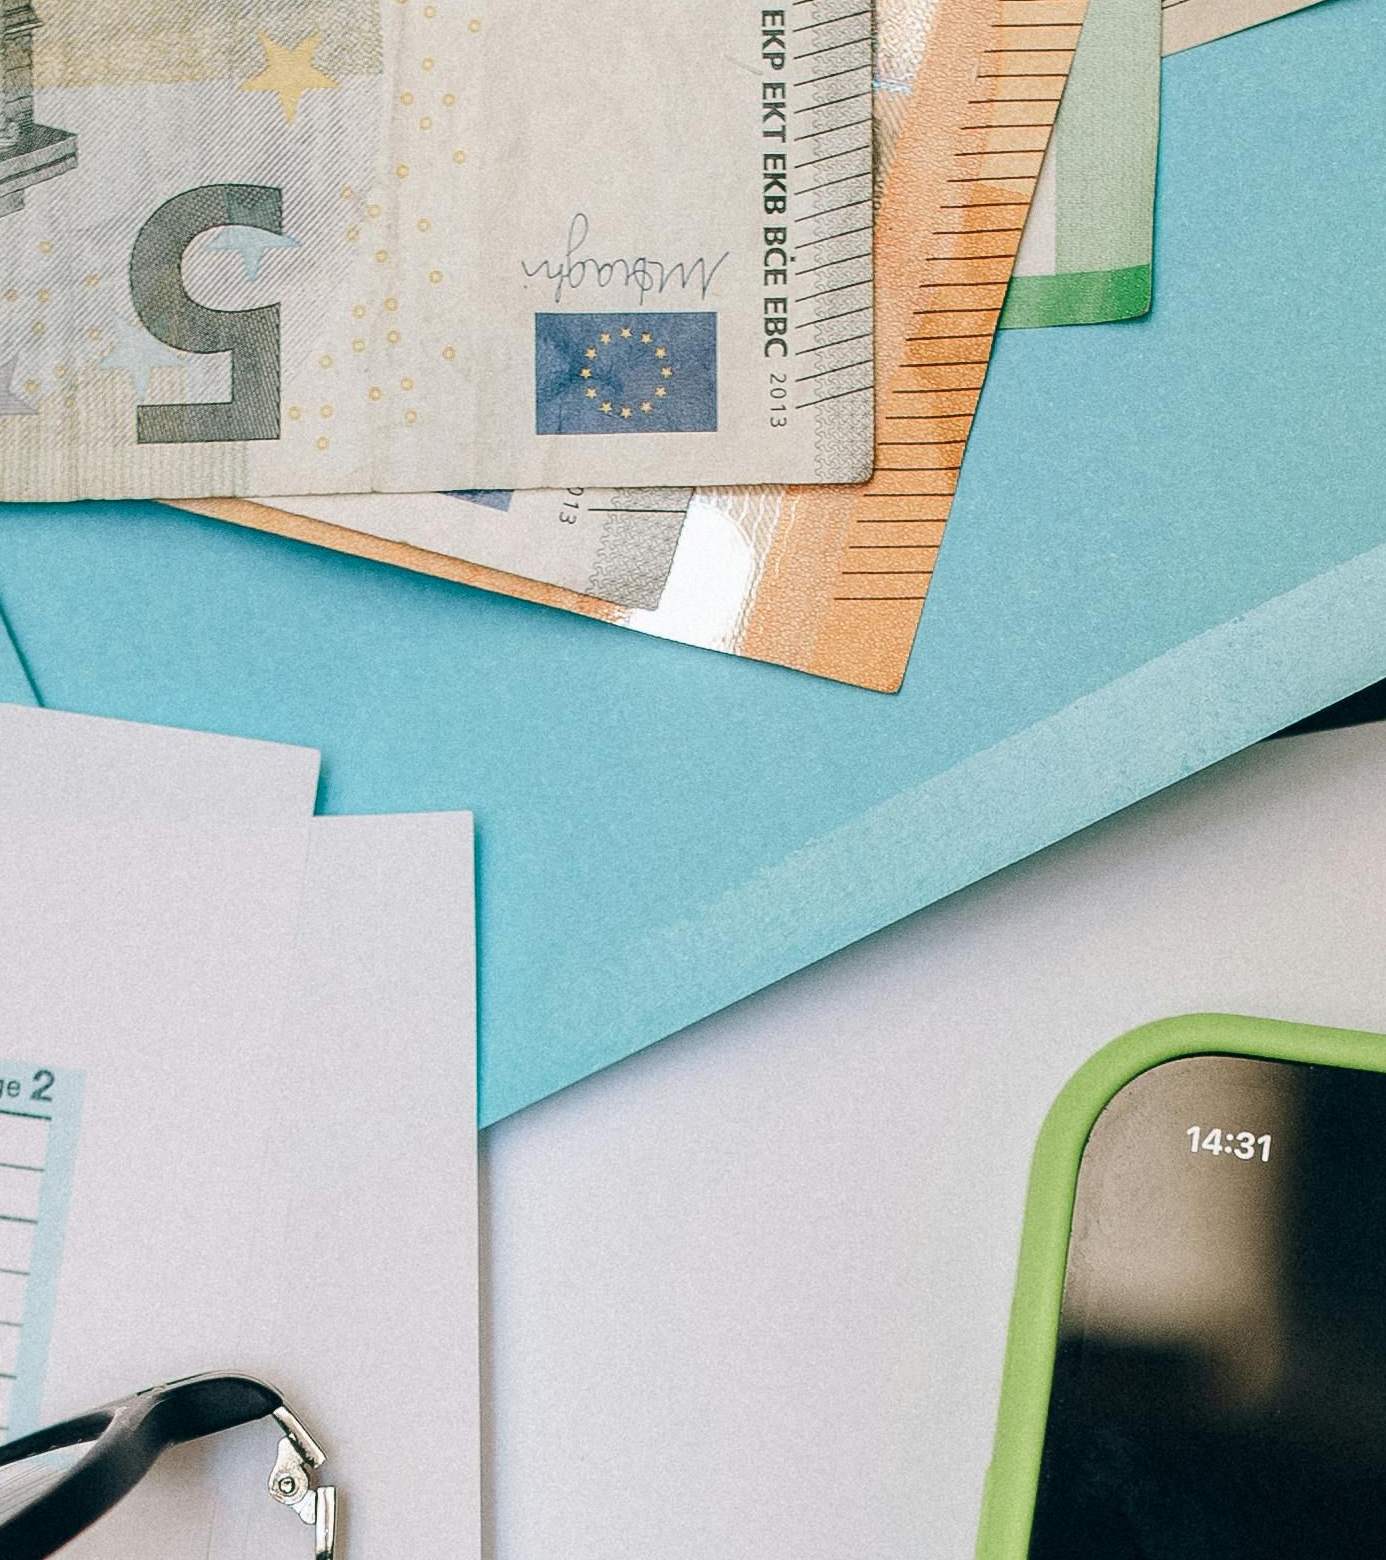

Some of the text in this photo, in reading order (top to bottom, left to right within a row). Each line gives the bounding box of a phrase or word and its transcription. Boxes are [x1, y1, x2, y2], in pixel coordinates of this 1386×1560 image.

[761, 10, 786, 72] EKP
[762, 154, 787, 216] EKB
[130, 183, 283, 443] 5
[763, 296, 789, 359] EBC
[769, 373, 787, 429] 2013
[560, 486, 585, 526] 013
[31, 1068, 56, 1102] 2
[1184, 1124, 1273, 1164] 14:31
